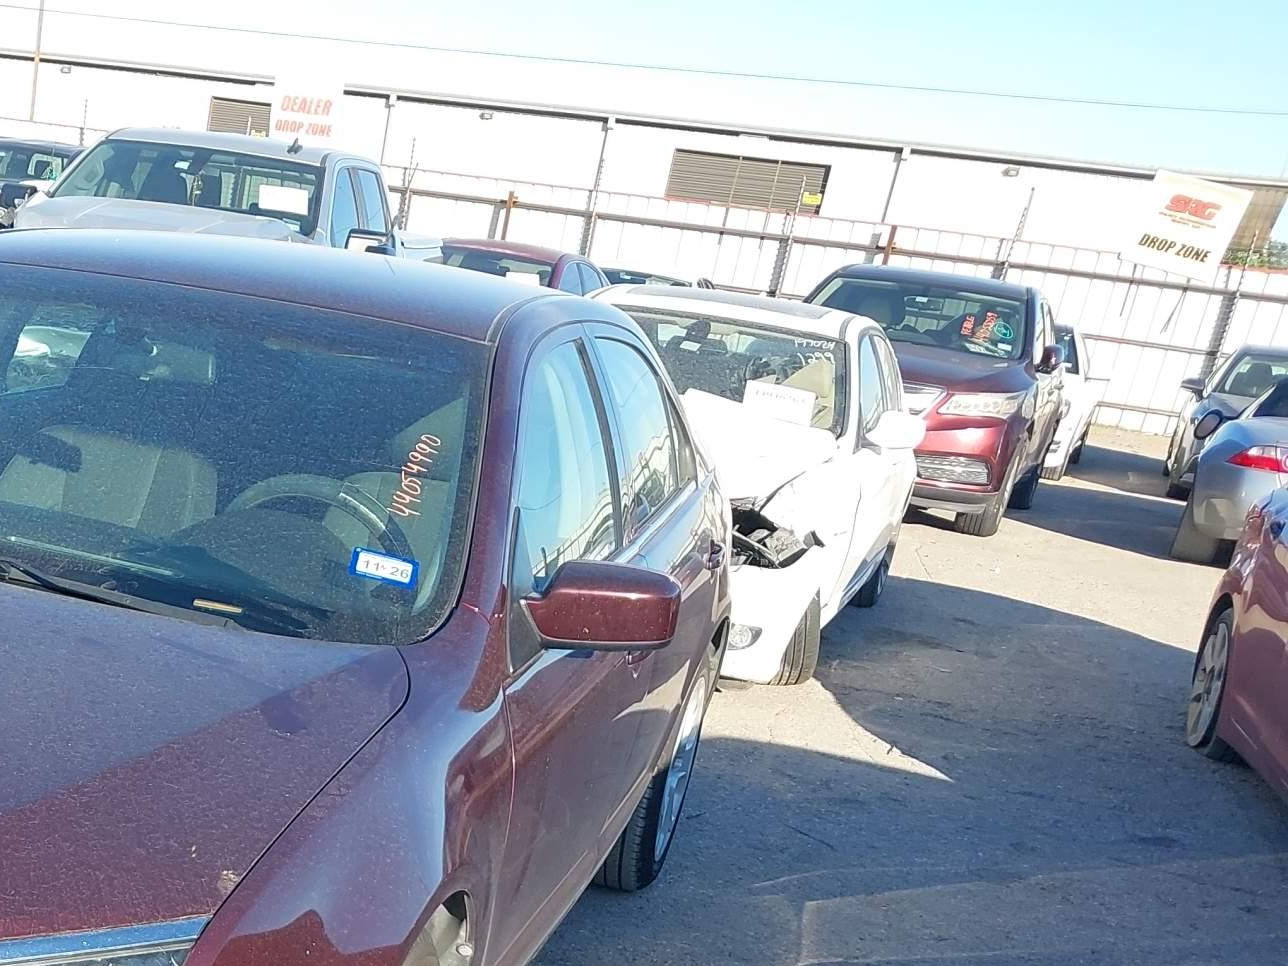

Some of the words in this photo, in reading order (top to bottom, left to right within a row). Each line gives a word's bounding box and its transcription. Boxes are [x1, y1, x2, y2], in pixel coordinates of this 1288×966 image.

[280, 95, 333, 116] DEALER
[275, 119, 304, 133] DROP
[306, 122, 332, 137] ZONE
[1138, 233, 1177, 253] DROP
[1174, 243, 1212, 263] ZONE
[387, 433, 441, 517] 44054990
